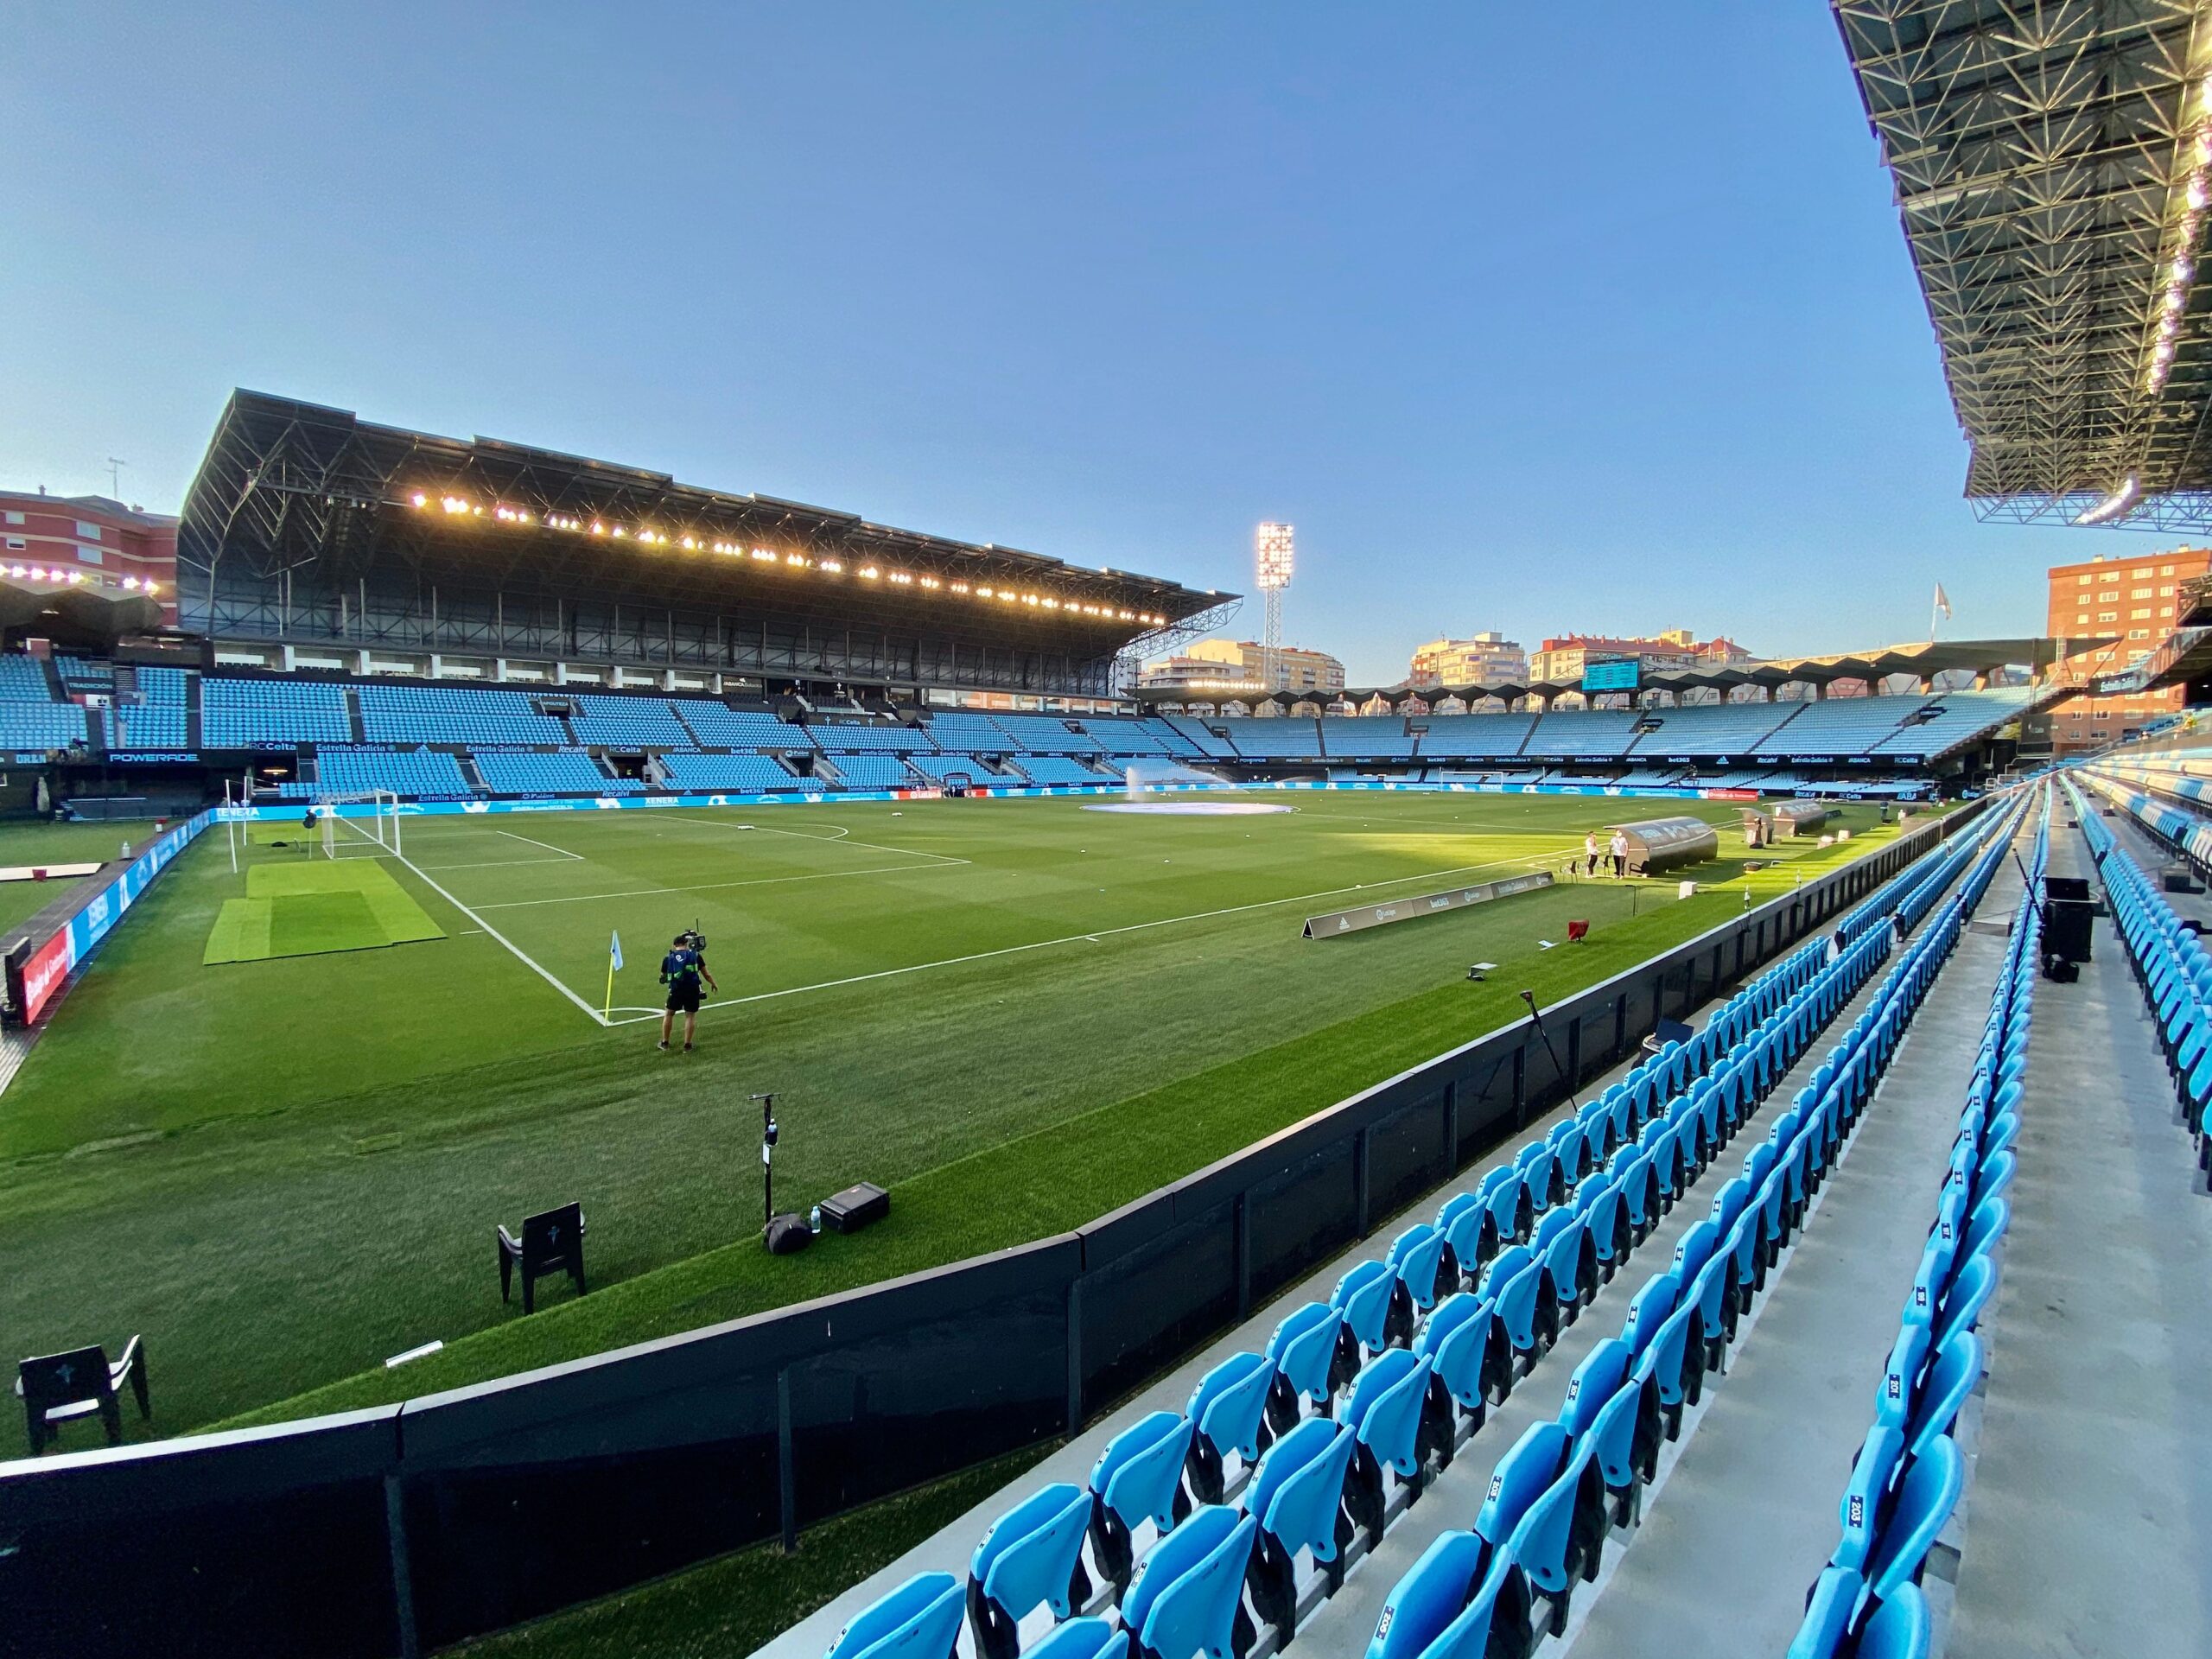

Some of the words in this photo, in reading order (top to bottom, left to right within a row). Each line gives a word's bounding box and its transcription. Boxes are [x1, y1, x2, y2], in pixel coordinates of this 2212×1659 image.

[110, 753, 200, 763] POWERADE
[450, 793, 479, 802] Galicia
[645, 797, 679, 805] XENERA
[1890, 1380, 1899, 1394] 201
[1850, 1502, 1862, 1522] 203
